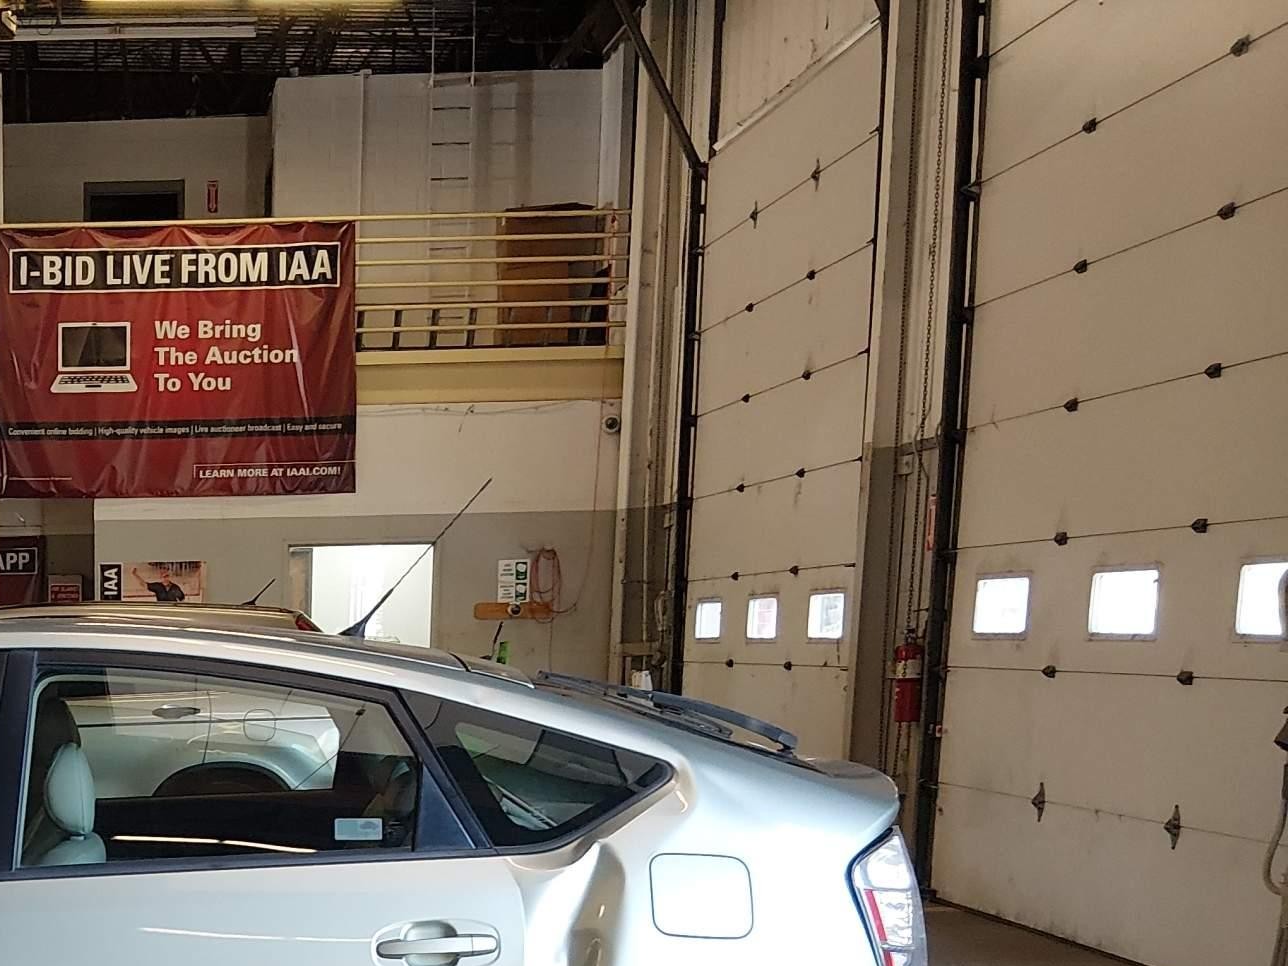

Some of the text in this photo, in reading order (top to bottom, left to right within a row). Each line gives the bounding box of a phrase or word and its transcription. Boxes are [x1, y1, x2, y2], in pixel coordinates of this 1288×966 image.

[19, 249, 332, 286] I-BID LIVE FROM IAA
[154, 319, 261, 342] We Bring
[154, 345, 299, 366] The Auction
[154, 372, 232, 392] To You
[98, 426, 138, 437] High-quality
[195, 425, 209, 433] Live
[247, 424, 282, 432] broadcast
[286, 423, 304, 433] Easy
[304, 423, 317, 431] and
[199, 468, 235, 478] LEARN
[237, 468, 268, 478] MORE
[270, 468, 284, 477] AT
[103, 567, 118, 596] IAA
